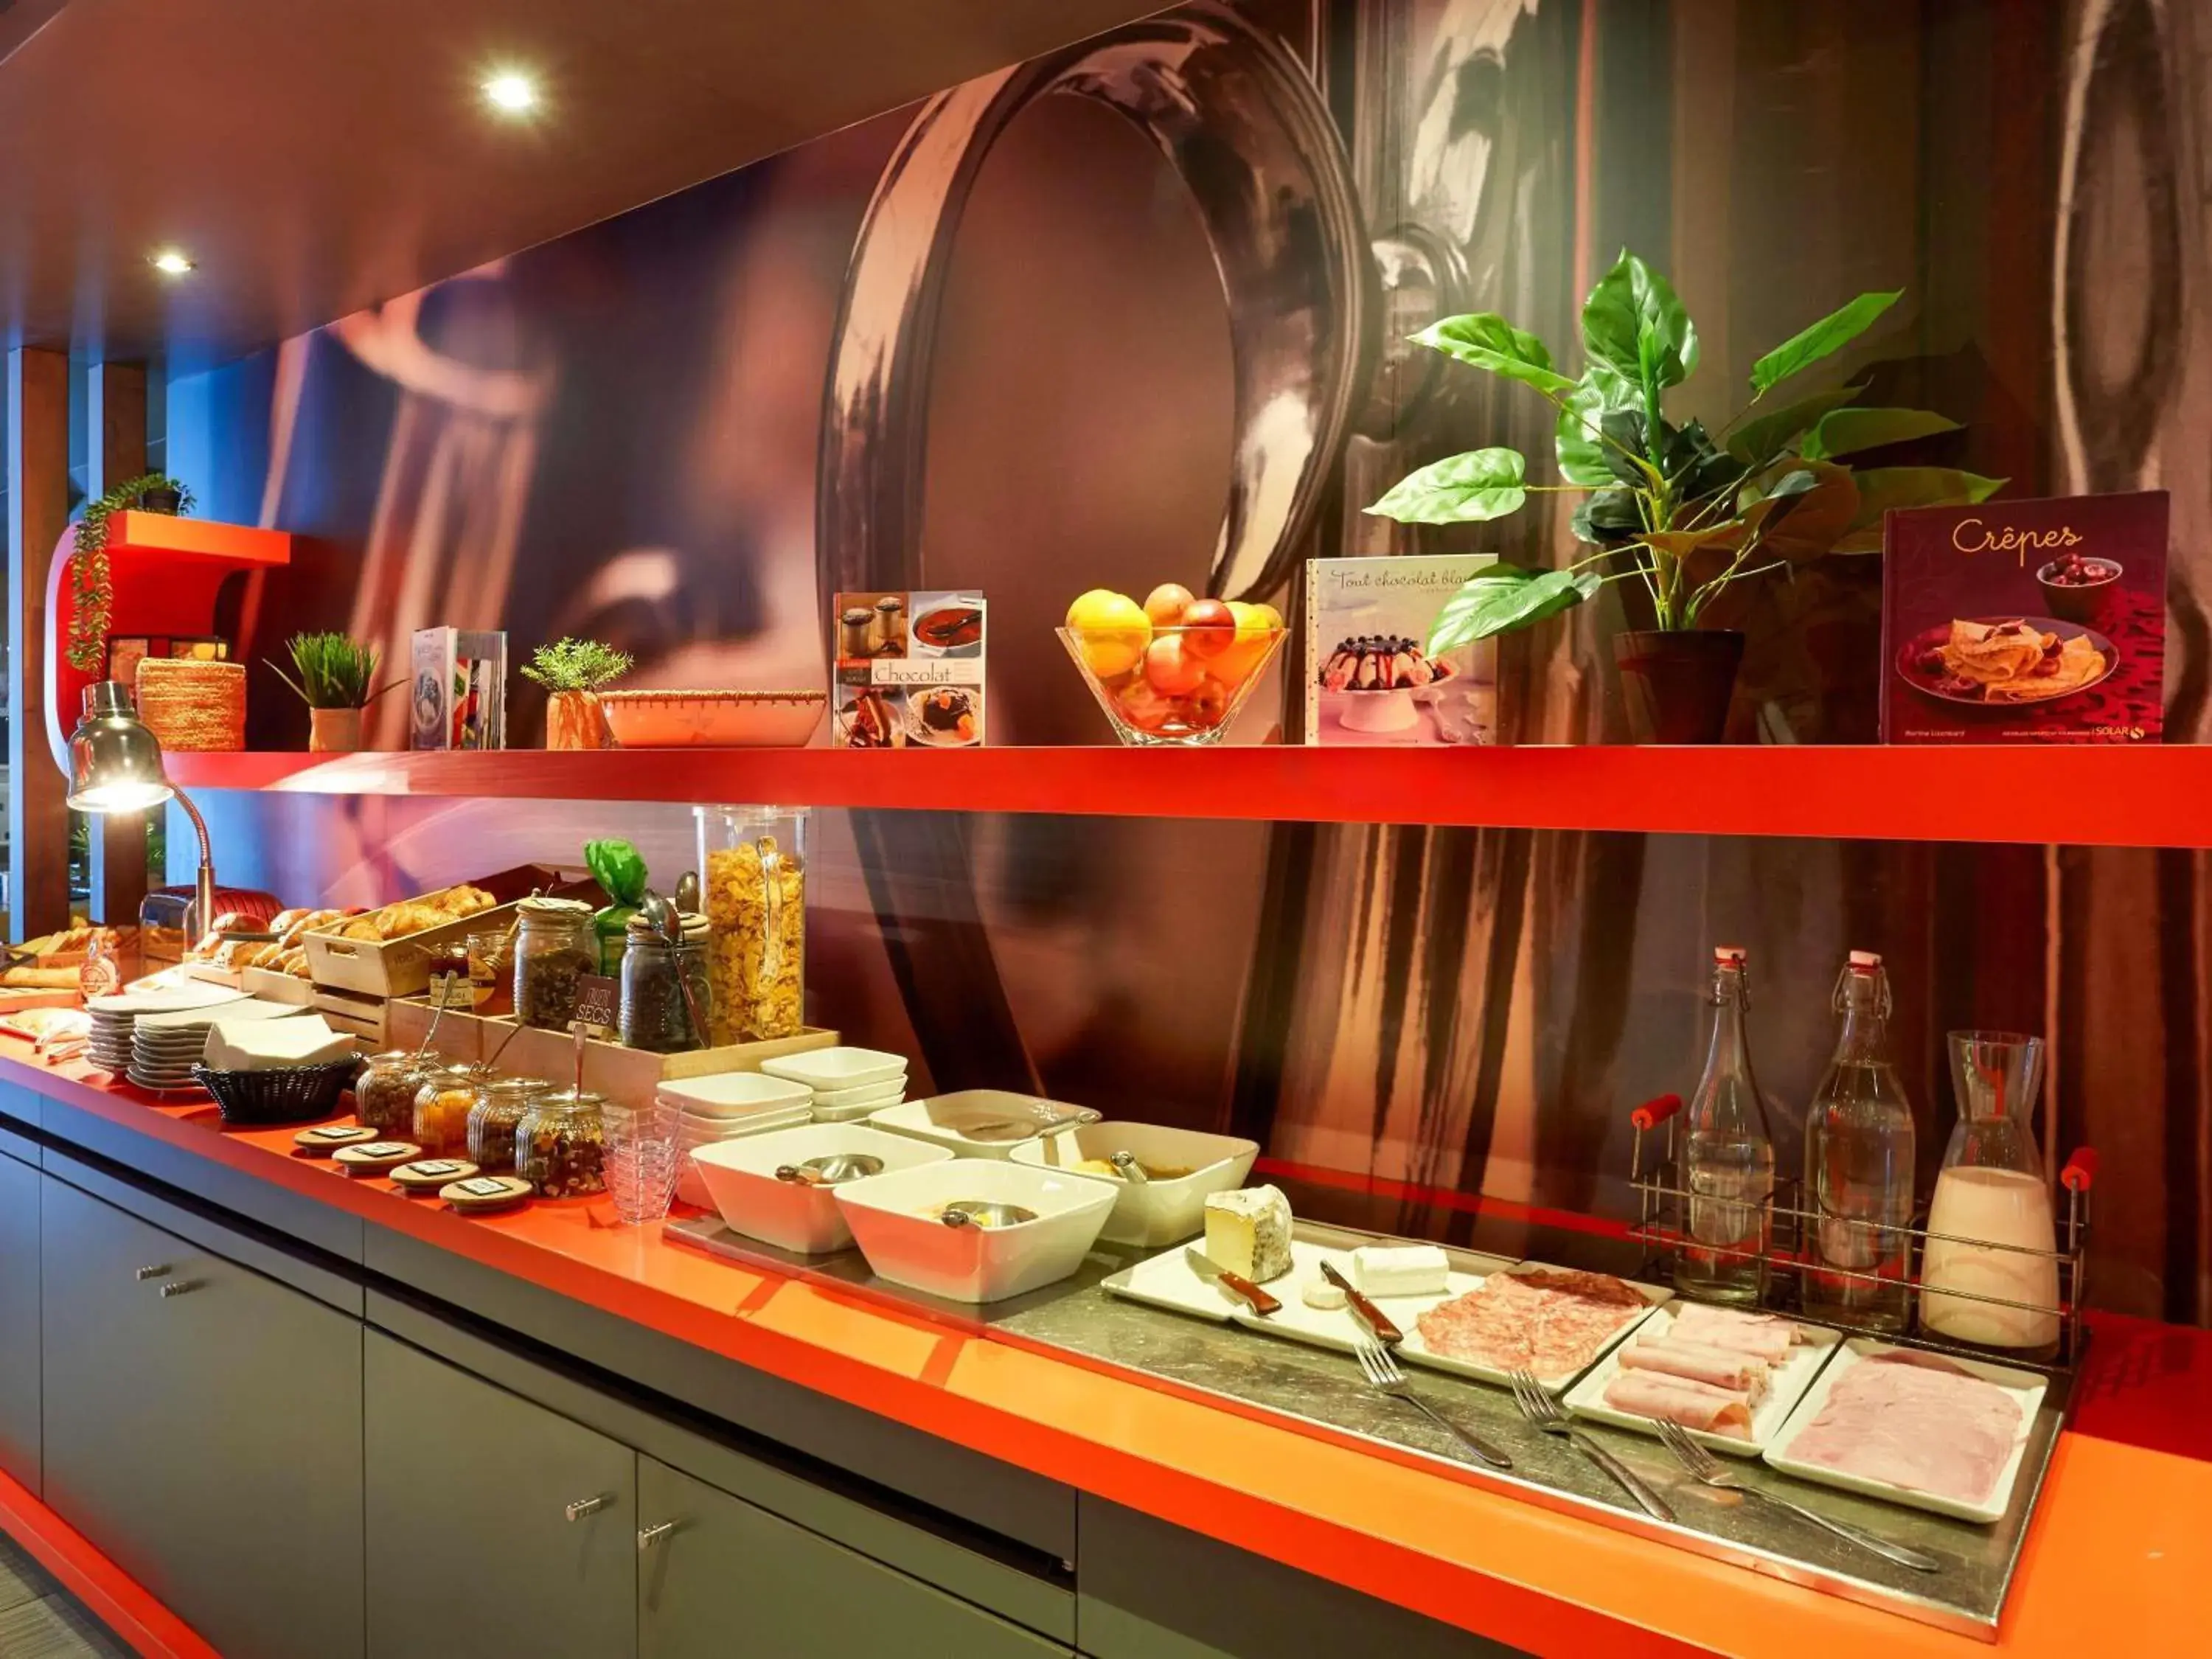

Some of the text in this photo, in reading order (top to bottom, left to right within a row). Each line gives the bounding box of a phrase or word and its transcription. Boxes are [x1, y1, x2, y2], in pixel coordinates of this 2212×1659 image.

[1952, 518, 2083, 567] Crêpes
[1374, 569, 1436, 587] chocolat
[874, 661, 952, 683] Chocolat
[2095, 726, 2129, 736] SOLAR
[576, 1004, 611, 1024] SECS
